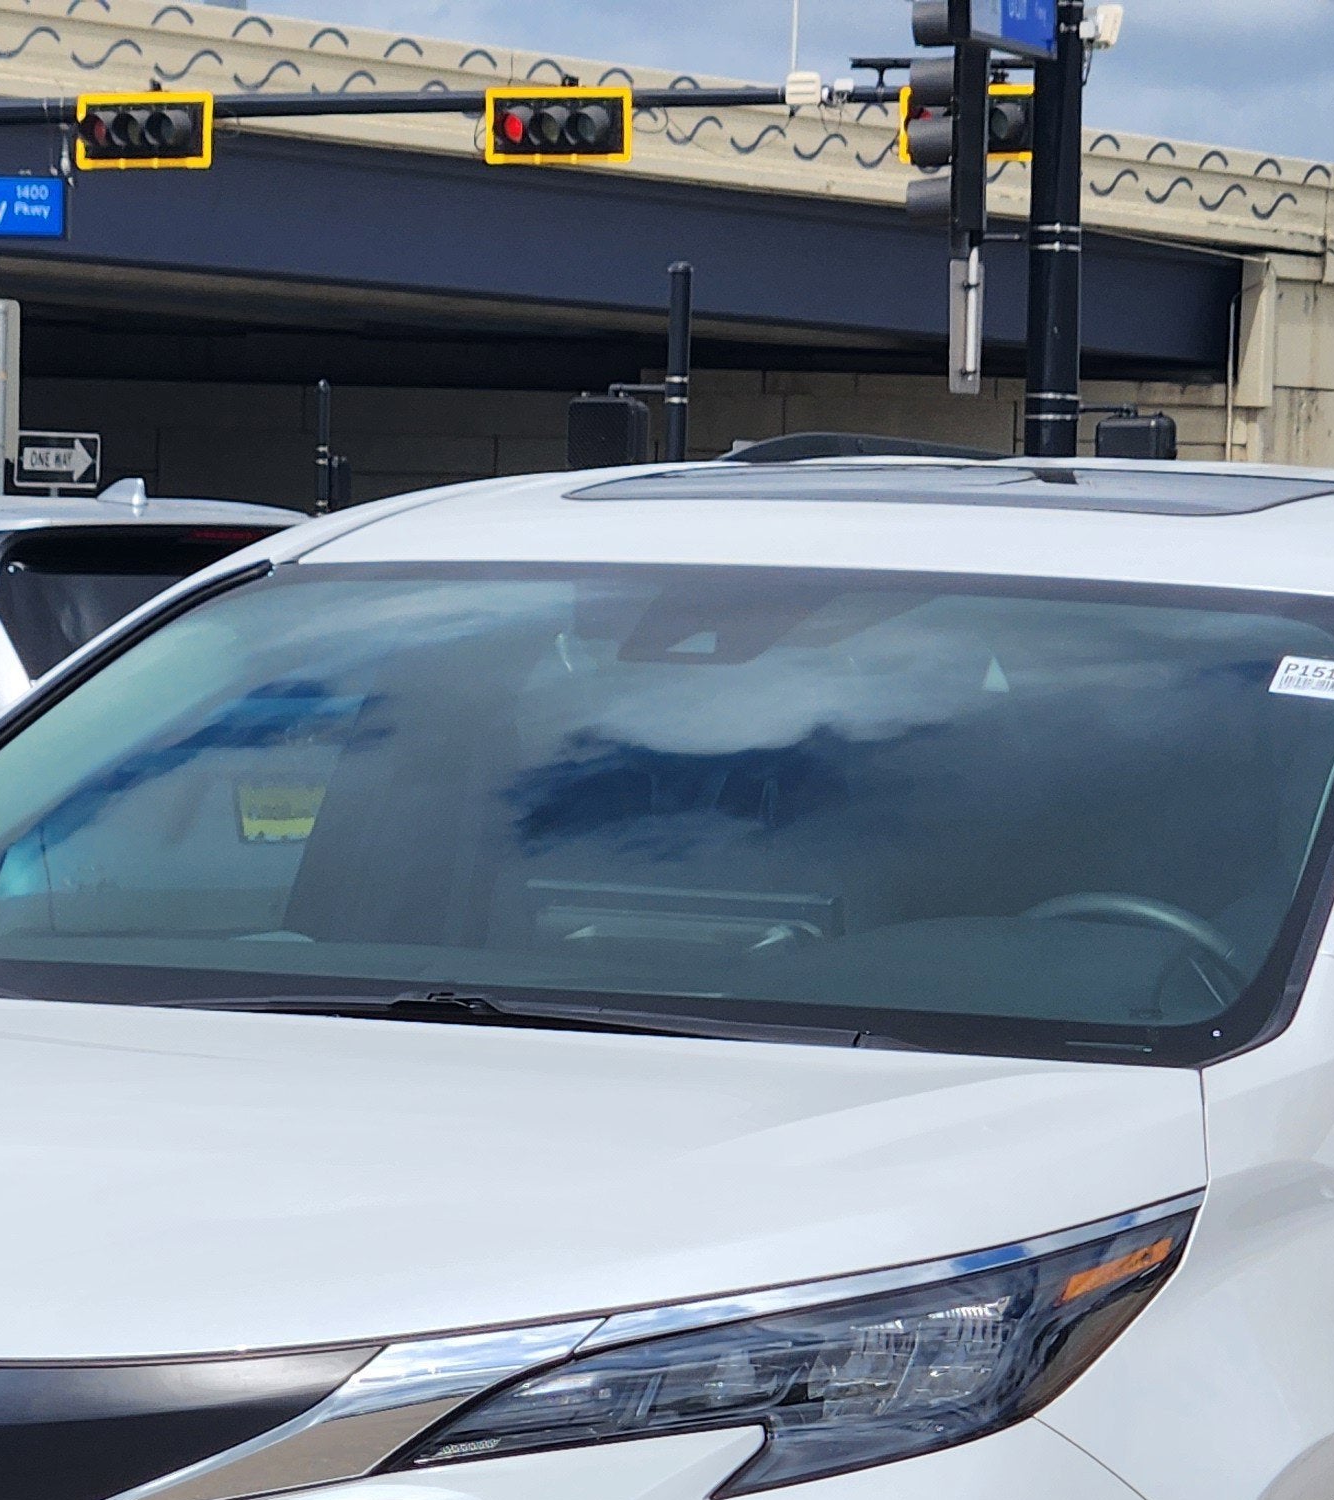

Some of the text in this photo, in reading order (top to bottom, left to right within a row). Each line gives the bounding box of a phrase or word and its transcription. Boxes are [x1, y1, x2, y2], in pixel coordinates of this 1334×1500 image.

[16, 184, 50, 200] 1400
[14, 202, 51, 220] Pkwy
[30, 450, 51, 468] ONE
